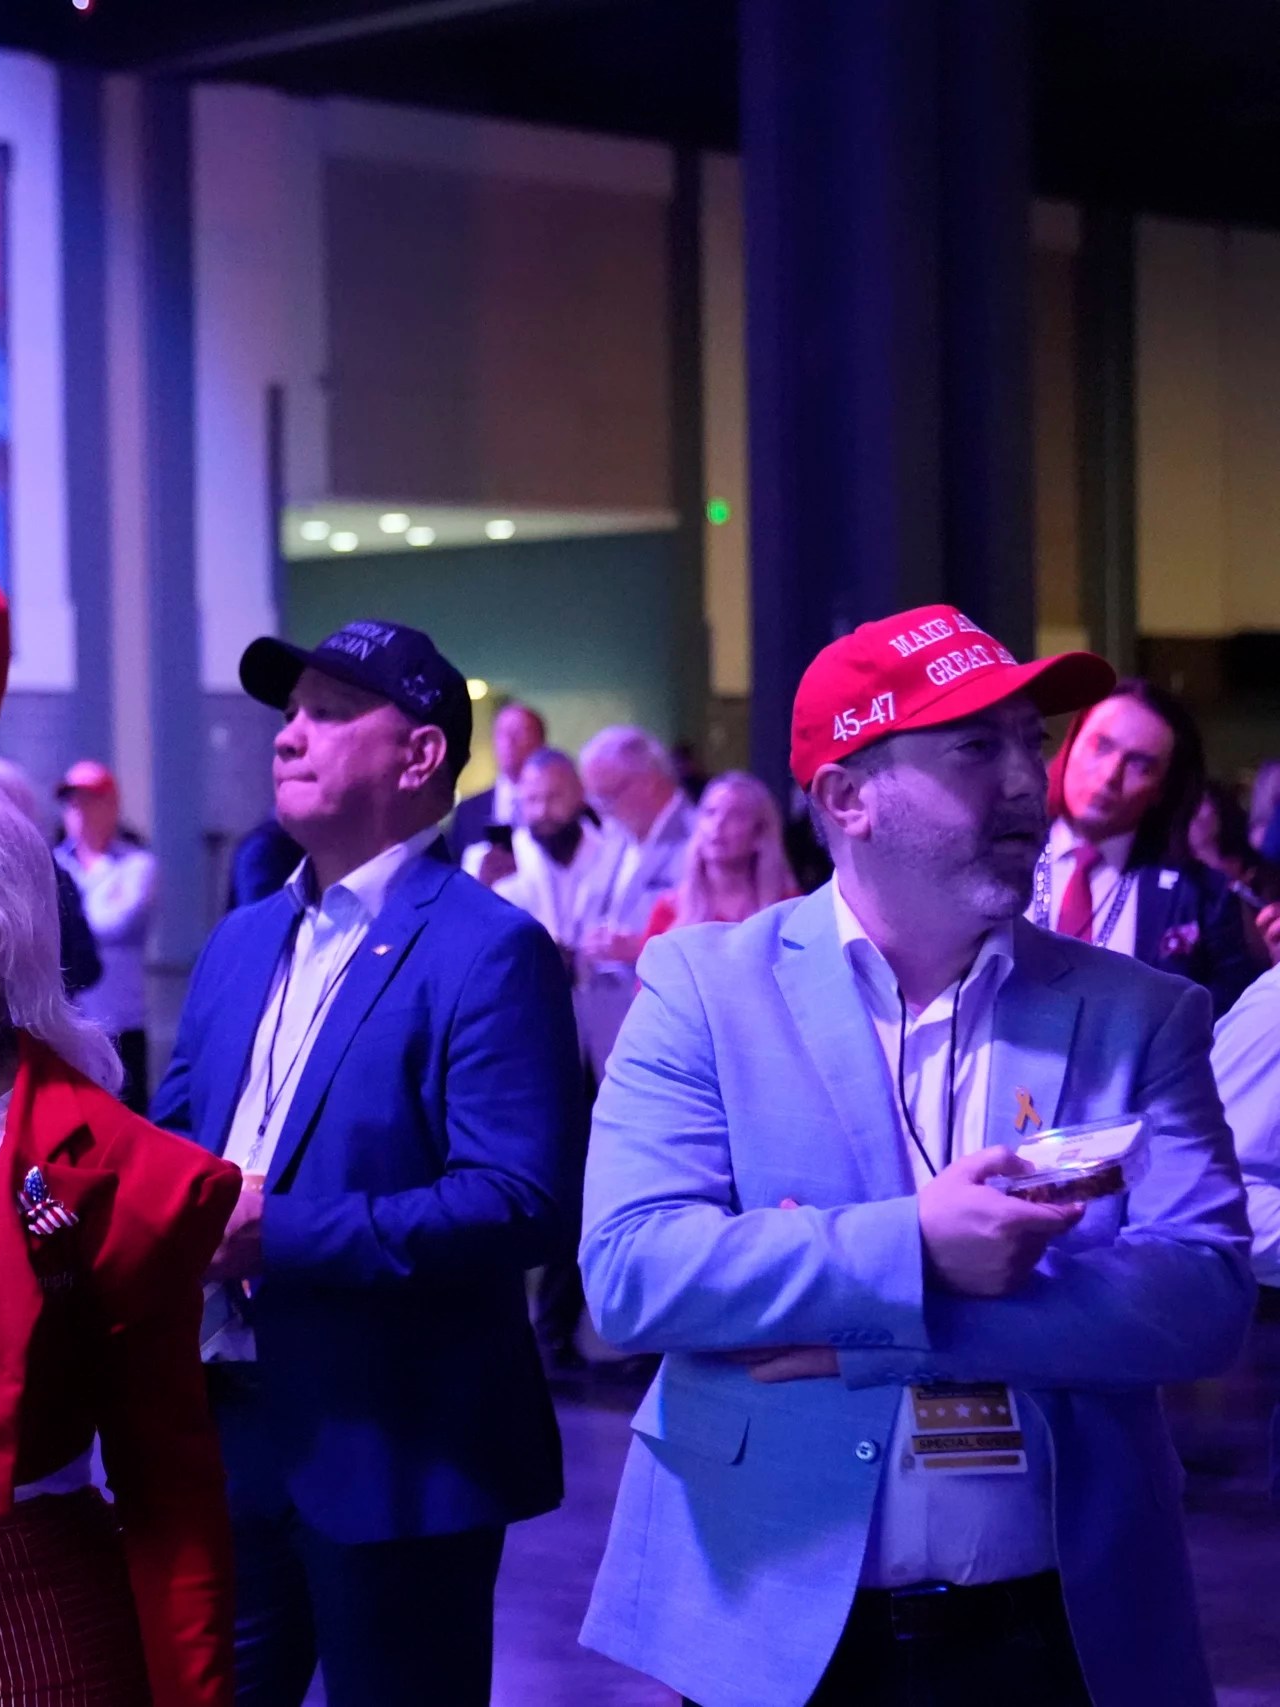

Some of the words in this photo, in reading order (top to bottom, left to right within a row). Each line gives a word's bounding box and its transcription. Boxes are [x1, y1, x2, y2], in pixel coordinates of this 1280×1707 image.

[888, 618, 954, 657] MAKE
[925, 645, 995, 685] GREAT
[833, 692, 897, 741] 45-47
